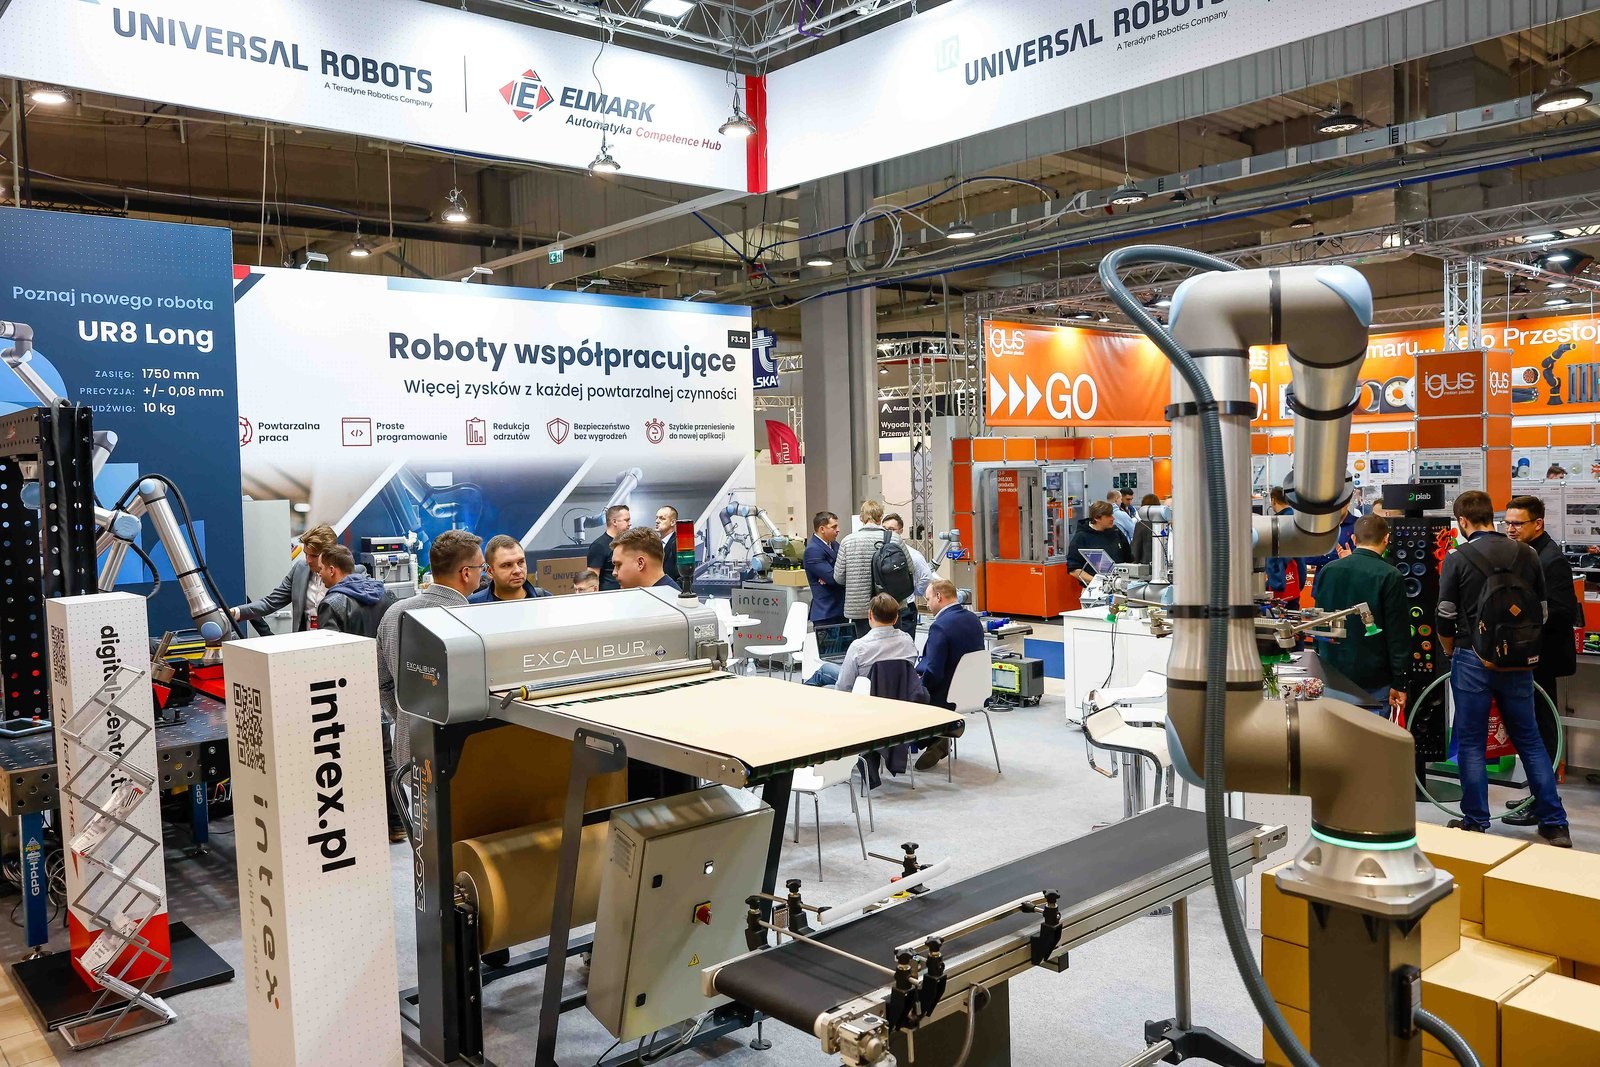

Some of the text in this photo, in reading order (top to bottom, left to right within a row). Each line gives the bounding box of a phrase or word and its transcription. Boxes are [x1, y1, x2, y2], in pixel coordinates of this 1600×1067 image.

[1116, 10, 1228, 51] A Teradyne Robotics Company
[112, 7, 433, 94] UNIVERSAL ROBOTS
[965, 0, 1224, 86] UNIVERSAL ROBO
[332, 83, 366, 96] Teradyne
[367, 90, 399, 102] Robotics
[400, 96, 433, 108] Company
[560, 86, 656, 123] ELMARK
[565, 114, 722, 151] Automatyka Competence Hub
[12, 286, 214, 311] Poznaj nowego robota
[78, 320, 214, 353] UR8 Long
[730, 335, 748, 344] F3.21
[989, 324, 1025, 358] igus
[388, 332, 736, 378] Roboty współpracujące
[95, 368, 200, 380] ZASIĘG: 1750 mm
[1424, 371, 1475, 399] igus
[1490, 368, 1510, 397] igus
[80, 387, 136, 396] PRECYZJA:
[168, 386, 196, 398] 0,08
[199, 388, 224, 396] mm
[404, 379, 737, 403] Więcej zysków z każdej powtarzalnej czynności
[1045, 372, 1098, 420] GO
[91, 402, 176, 416] UDŹWIG: 10 kg
[258, 422, 320, 430] Powtarzalna
[376, 422, 405, 430] Proste
[376, 432, 448, 443] programowanie
[493, 422, 530, 432] Redukcja
[493, 432, 530, 441] odrzutów
[574, 423, 630, 432] Bezpieczeństwo
[574, 432, 628, 442] bez wygrodzeń
[668, 423, 735, 432] Szybkie przeniesienie
[669, 432, 726, 442] do nowej aplikacji
[880, 422, 911, 430] Wygodn
[881, 430, 919, 438] Przemys
[258, 434, 289, 444] praca
[1415, 492, 1432, 501] plab
[738, 594, 778, 606] intrex
[523, 640, 646, 670] EXCALIBUR
[308, 677, 356, 874] intrex.pl
[412, 765, 424, 912] EXCALIBUR
[30, 861, 40, 896] GPPH
[254, 794, 280, 1010] intrex
